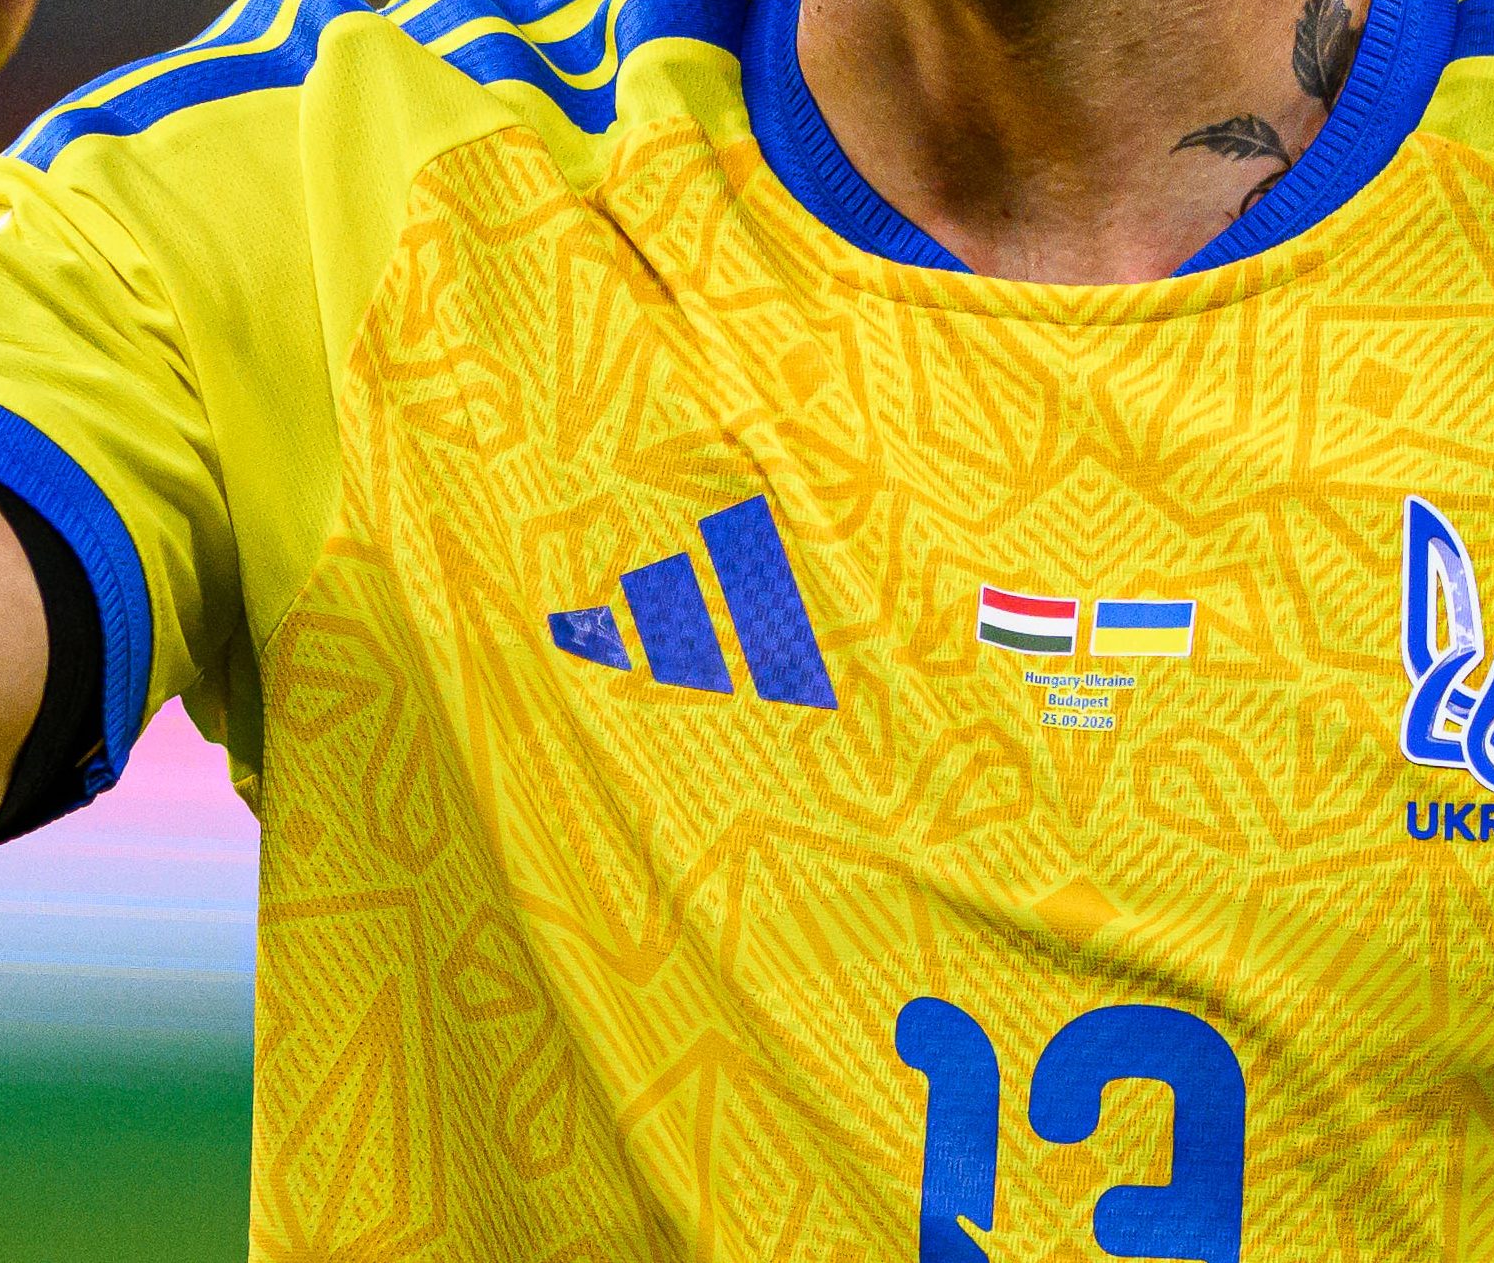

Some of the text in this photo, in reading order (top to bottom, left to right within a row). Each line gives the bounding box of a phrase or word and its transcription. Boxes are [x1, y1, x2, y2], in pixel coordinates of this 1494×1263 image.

[1024, 671, 1136, 688] Hungary-Ukraine
[1048, 693, 1109, 709] Budapest
[1042, 712, 1114, 729] 25.09.2026
[894, 996, 1247, 1263] 13
